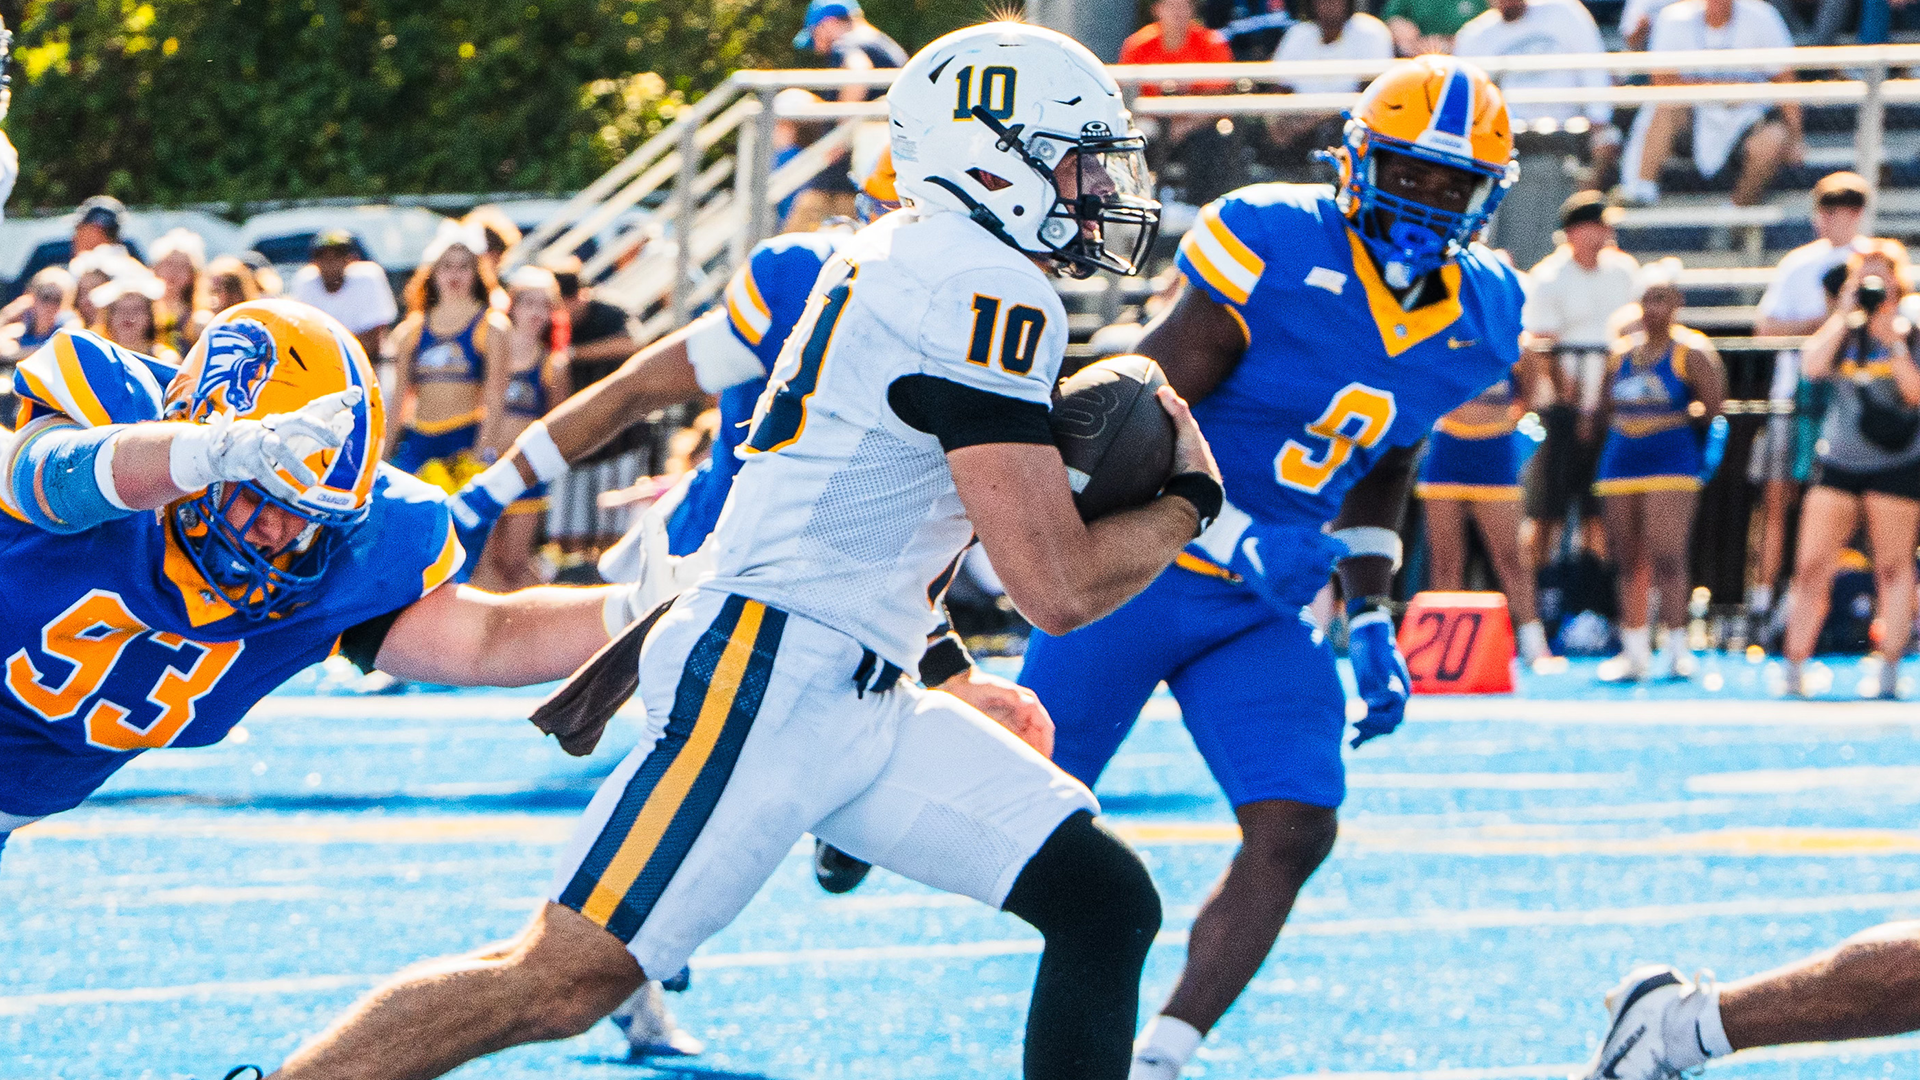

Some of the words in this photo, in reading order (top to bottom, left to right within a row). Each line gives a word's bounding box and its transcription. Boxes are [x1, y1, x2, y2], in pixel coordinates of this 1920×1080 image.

[953, 65, 1018, 122] 10
[966, 292, 1047, 376] 10
[1273, 381, 1397, 495] 9
[5, 588, 246, 752] 93
[1405, 612, 1482, 681] 20
